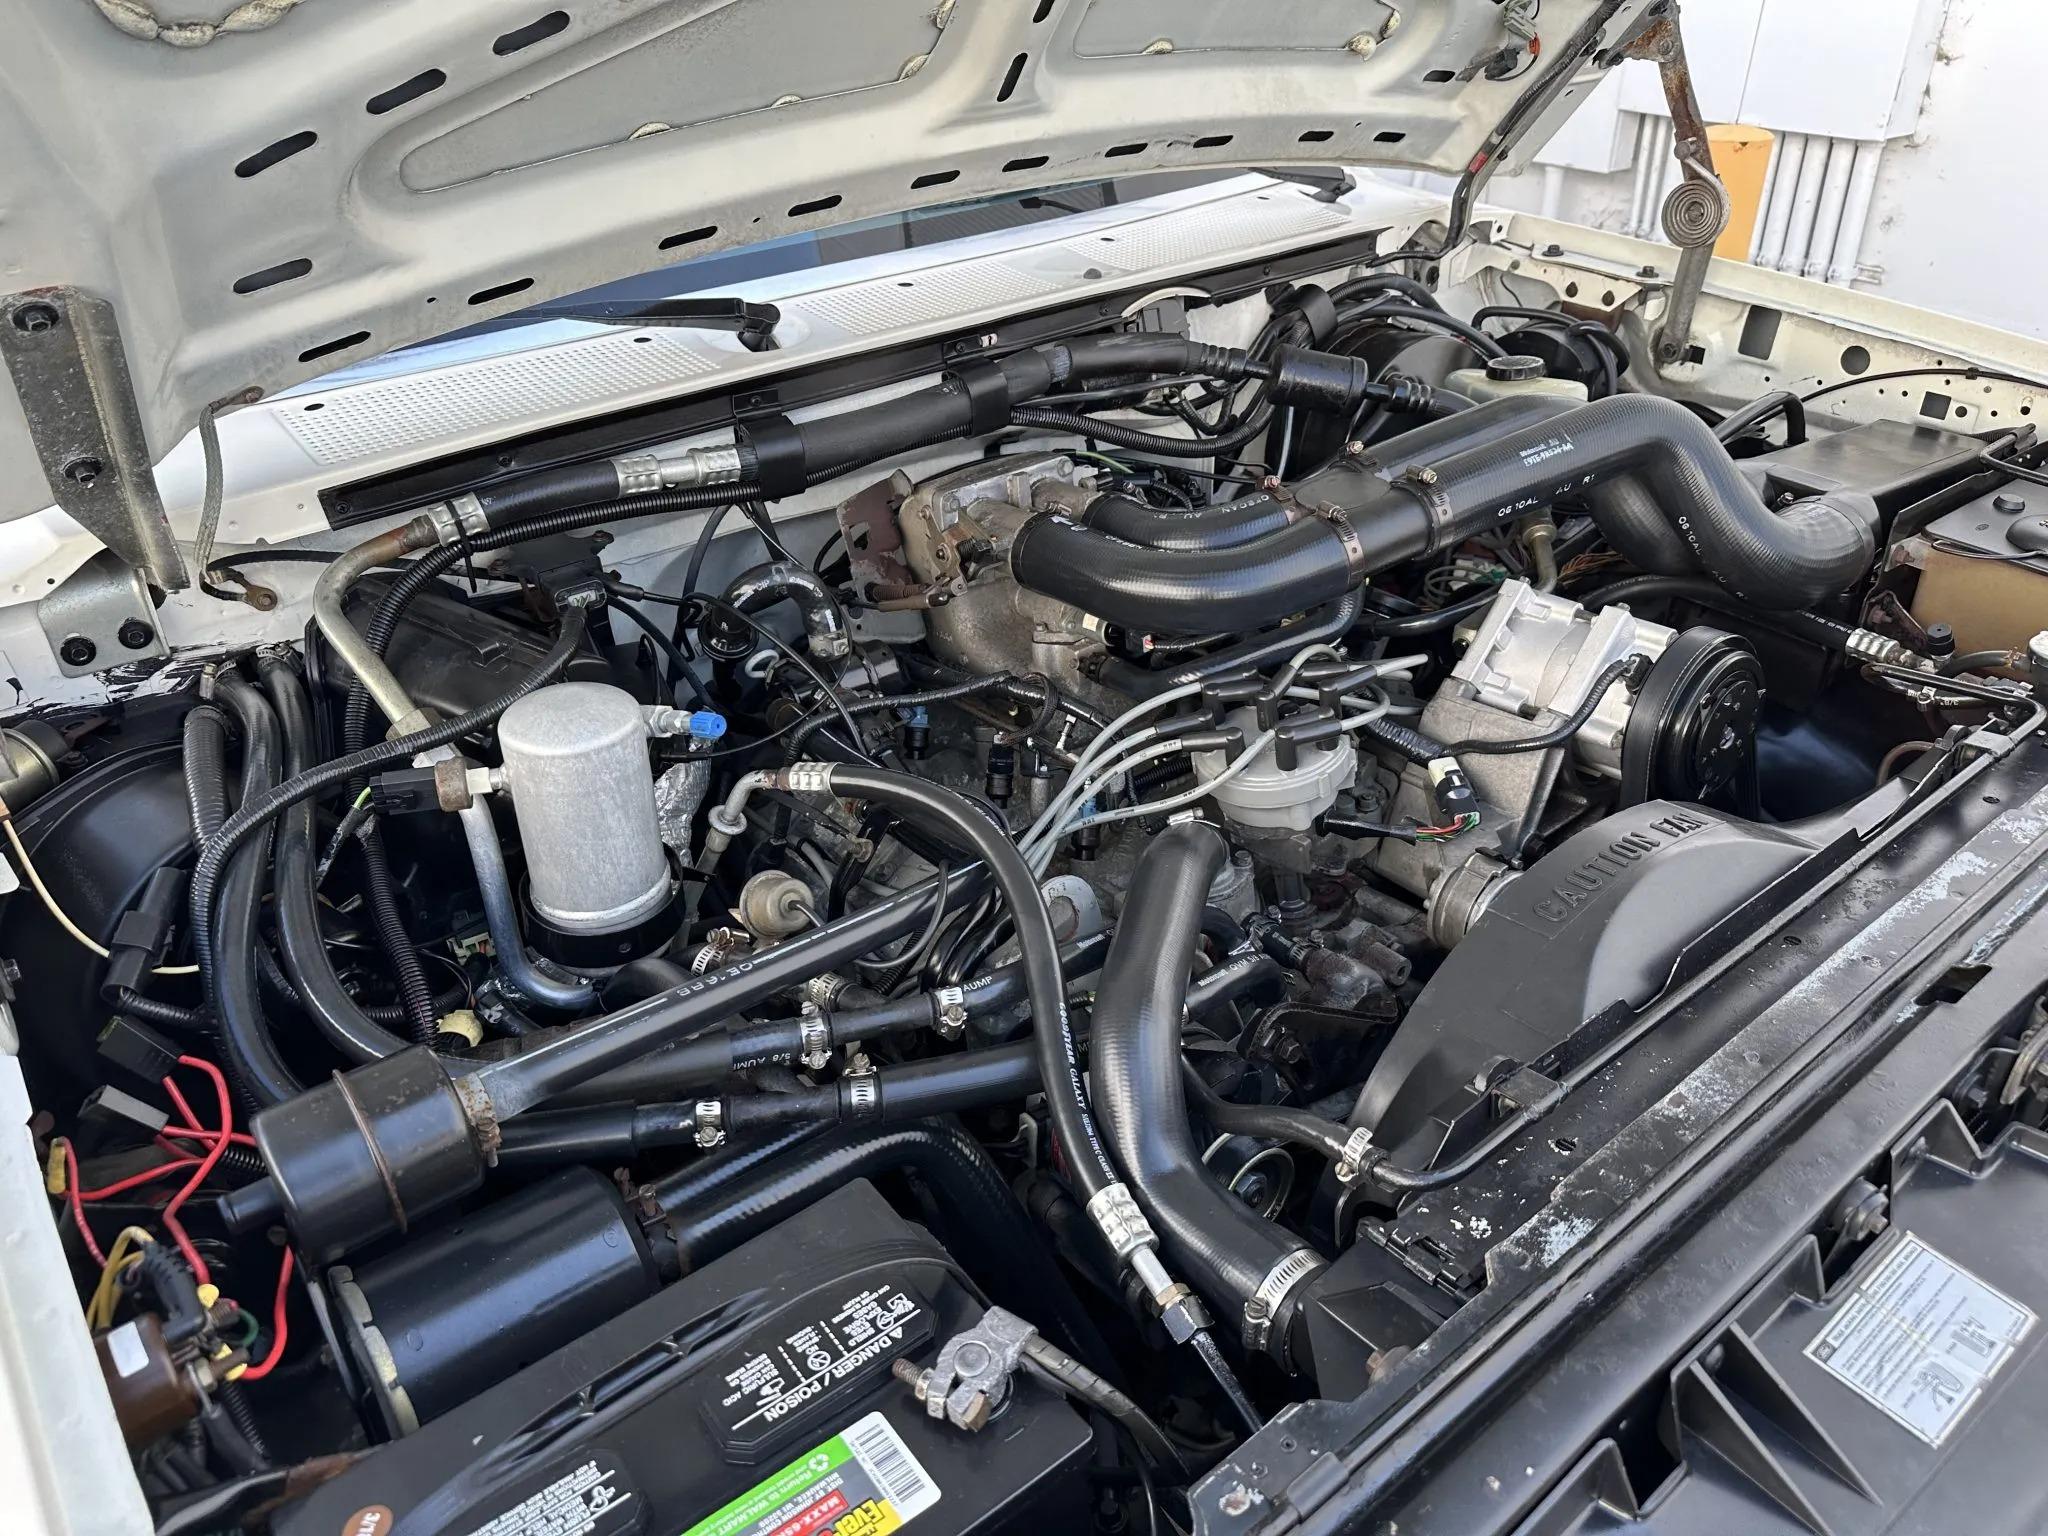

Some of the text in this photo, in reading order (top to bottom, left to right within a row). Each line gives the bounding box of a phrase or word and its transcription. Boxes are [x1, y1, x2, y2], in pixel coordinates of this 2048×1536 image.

[1533, 813, 1708, 922] CAUTION FAN
[963, 976, 992, 992] AUMP
[1059, 1002, 1075, 1064] GOODYEAR
[1070, 1068, 1087, 1110] GALAXY
[842, 1305, 882, 1334] EXPLOSIVE
[851, 1299, 878, 1319] GASES
[847, 1326, 875, 1347] SHIELD
[849, 1320, 870, 1337] EYES
[804, 1343, 819, 1355] NO
[830, 1333, 893, 1378] DANGER
[721, 1367, 779, 1407] SULFURIC ACID
[762, 1379, 822, 1422] POISON
[522, 1495, 583, 1535] MEDICAL HELP
[563, 1502, 587, 1520] WITH
[716, 1469, 812, 1535] Return to WALMART
[780, 1496, 815, 1522] JOHNSON
[561, 1508, 591, 1530] FLUSH
